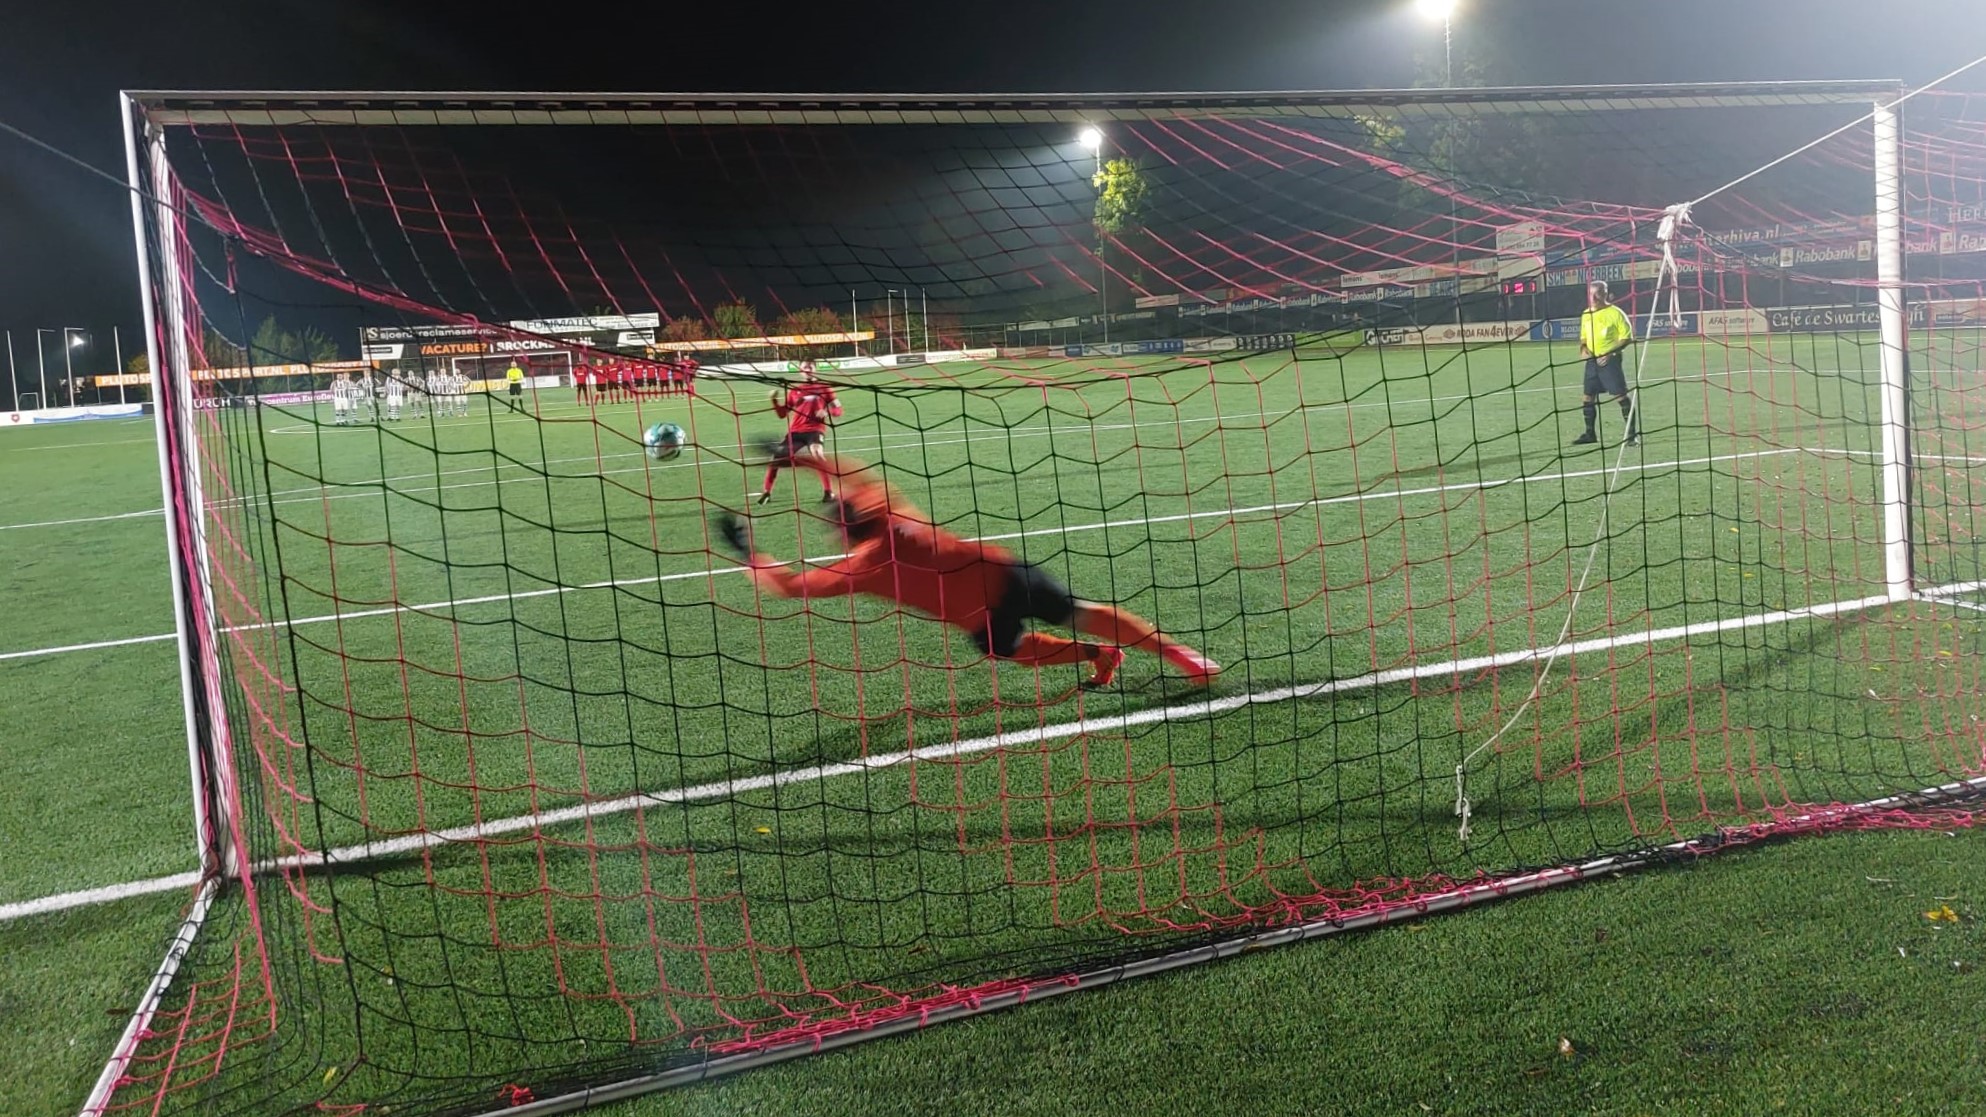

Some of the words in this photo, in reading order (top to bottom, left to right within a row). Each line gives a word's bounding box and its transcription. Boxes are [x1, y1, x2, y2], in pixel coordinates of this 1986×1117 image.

[1795, 246, 1855, 264] Rabobank
[1709, 317, 1729, 326] AFAS
[1772, 310, 1801, 328] Café
[1805, 311, 1820, 325] de
[419, 327, 497, 338] reclameservic
